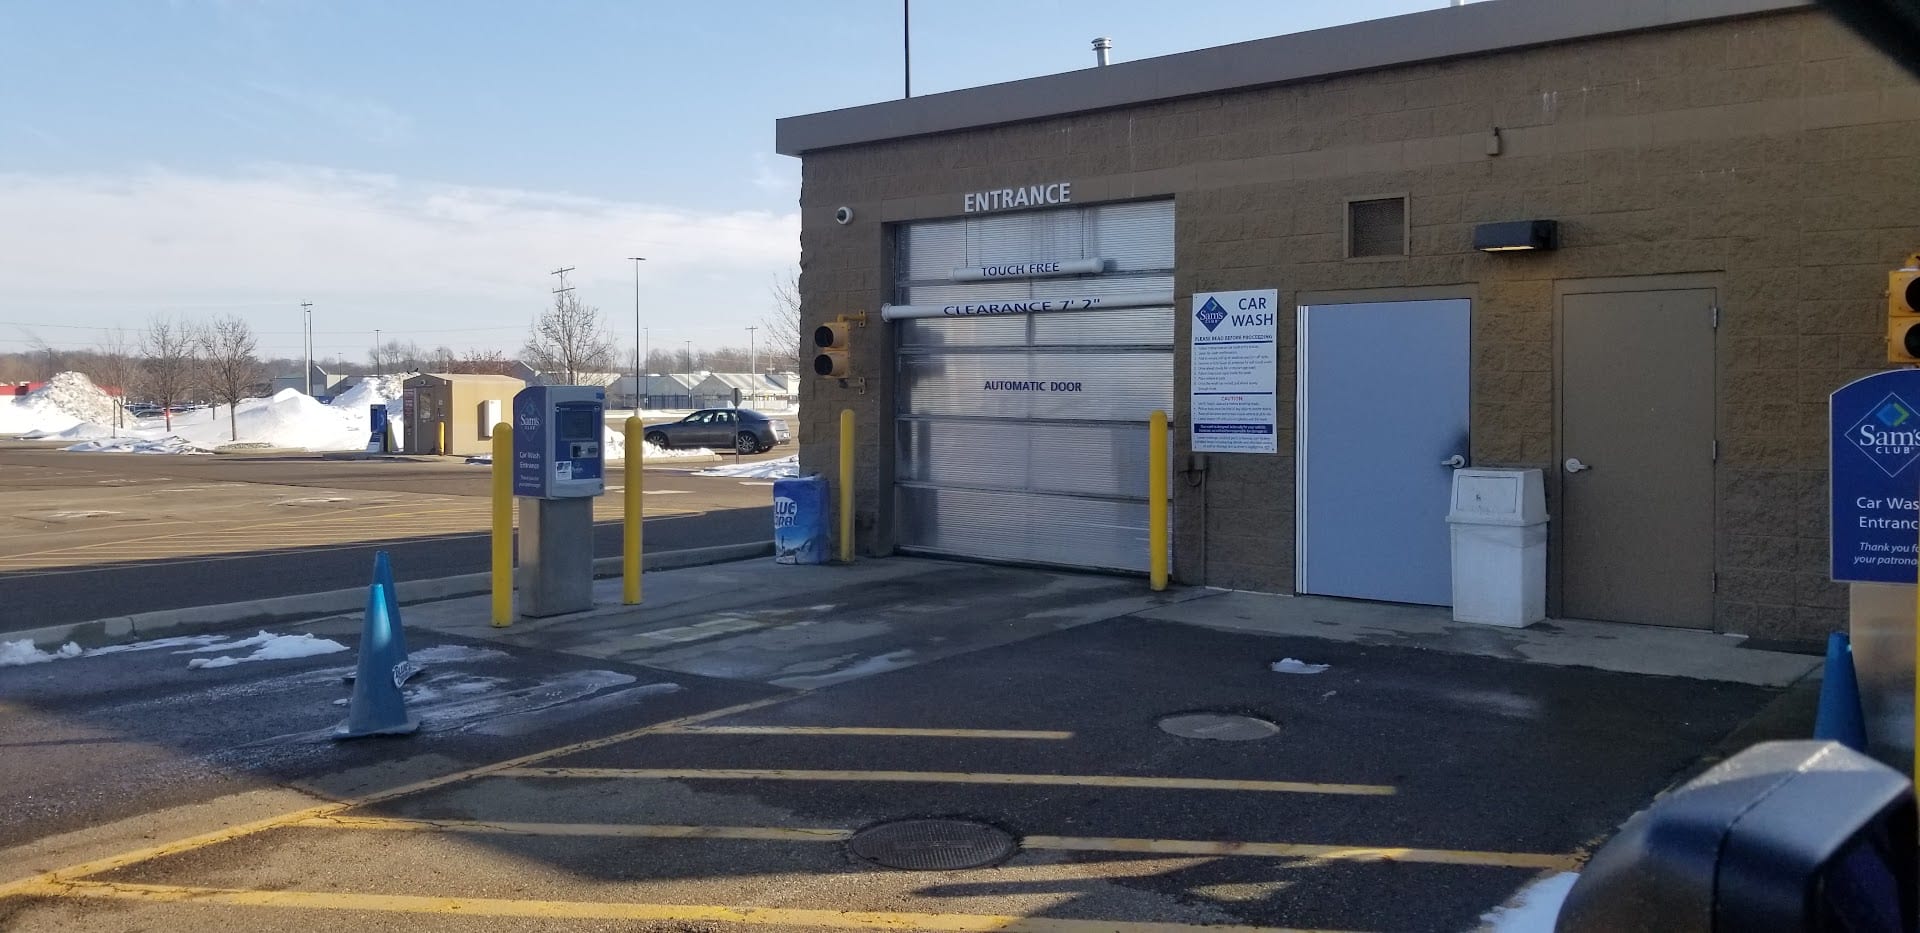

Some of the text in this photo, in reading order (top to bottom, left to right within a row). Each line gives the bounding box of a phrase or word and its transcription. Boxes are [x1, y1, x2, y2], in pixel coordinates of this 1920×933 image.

[964, 182, 1071, 213] ENTRANCE
[981, 262, 1060, 276] TOUCH FREE
[943, 301, 1052, 315] CLEARANCE
[1238, 297, 1267, 310] CAR
[1231, 313, 1273, 327] WASH
[984, 381, 1082, 392] AUTOMATIC DOOR
[1860, 424, 1920, 446] Sam's
[1876, 446, 1910, 454] CLUB
[1856, 497, 1920, 510] Car Was
[1859, 516, 1920, 530] Entranc
[1860, 542, 1889, 552] Thank
[1890, 545, 1910, 554] you
[1853, 556, 1918, 566] your patrona
